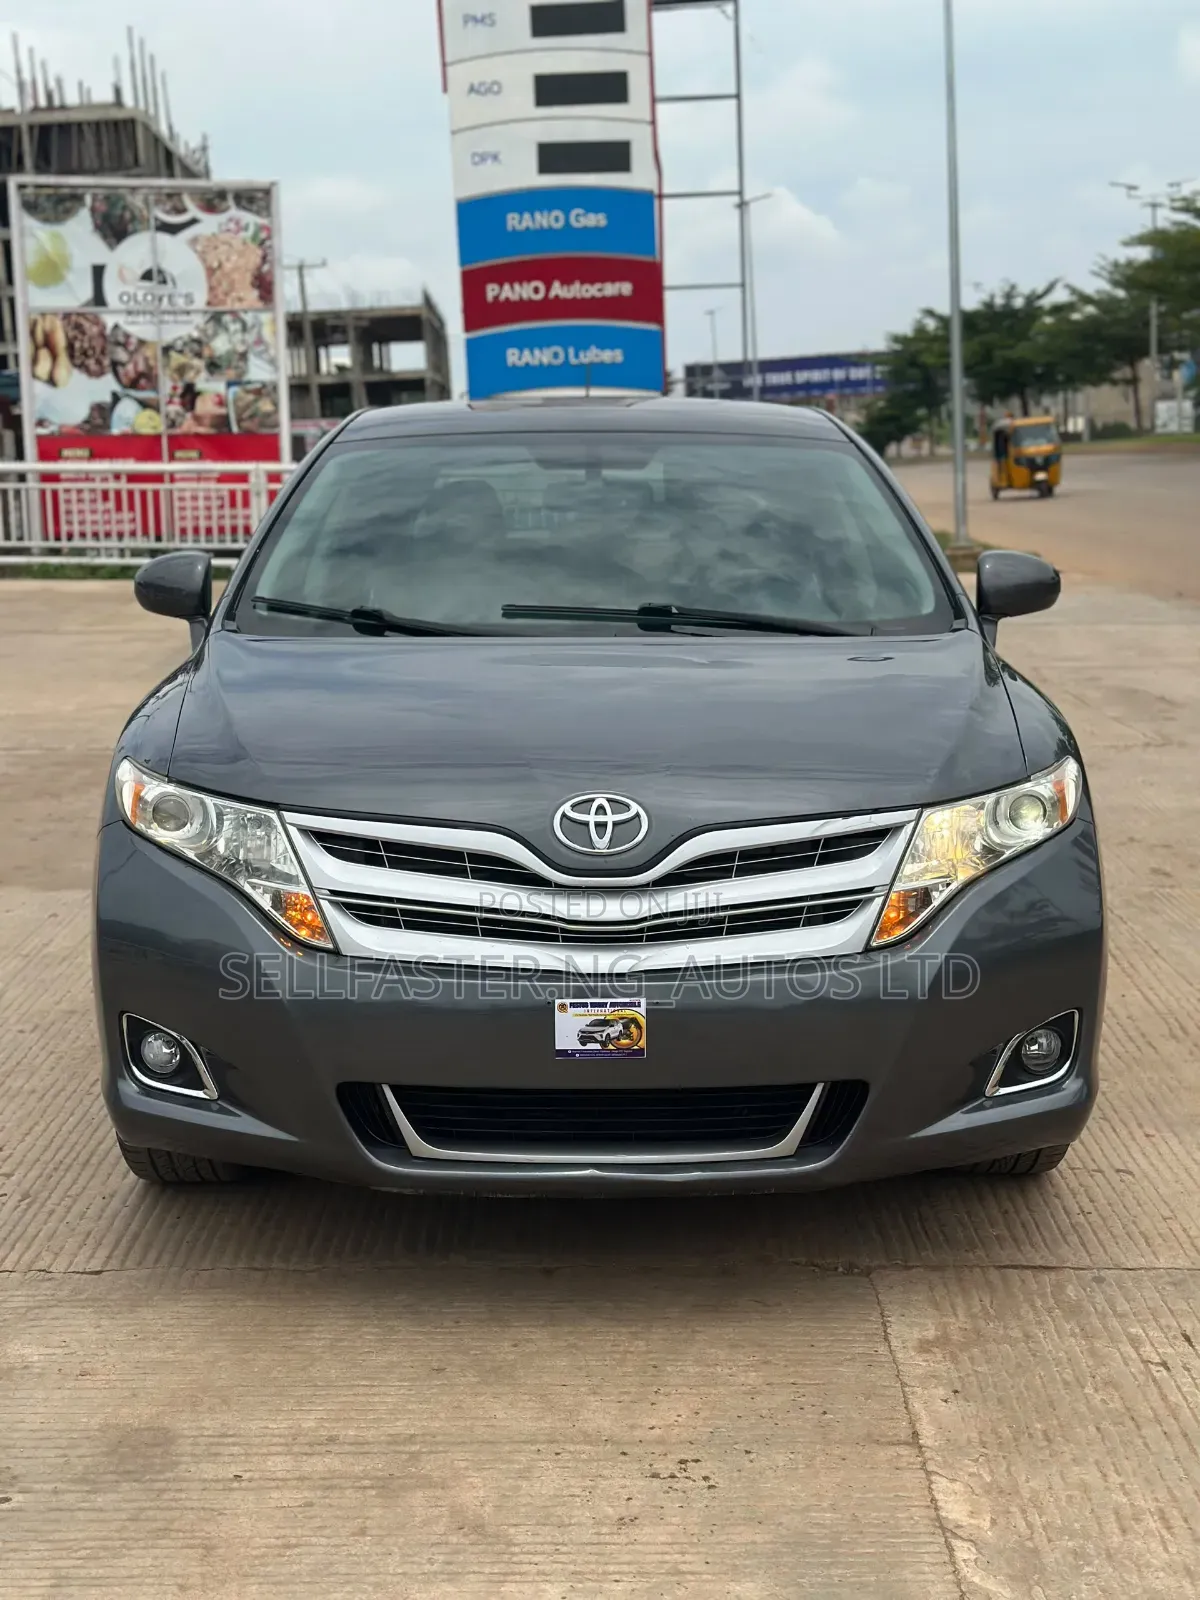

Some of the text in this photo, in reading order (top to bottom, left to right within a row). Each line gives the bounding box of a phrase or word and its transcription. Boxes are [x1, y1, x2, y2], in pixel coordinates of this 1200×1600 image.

[462, 12, 497, 29] PMS
[467, 80, 502, 97] AGO
[470, 151, 503, 167] DPK
[506, 208, 608, 231] RANO Gas
[549, 280, 633, 300] Autocare
[506, 345, 624, 367] RANO Lubes
